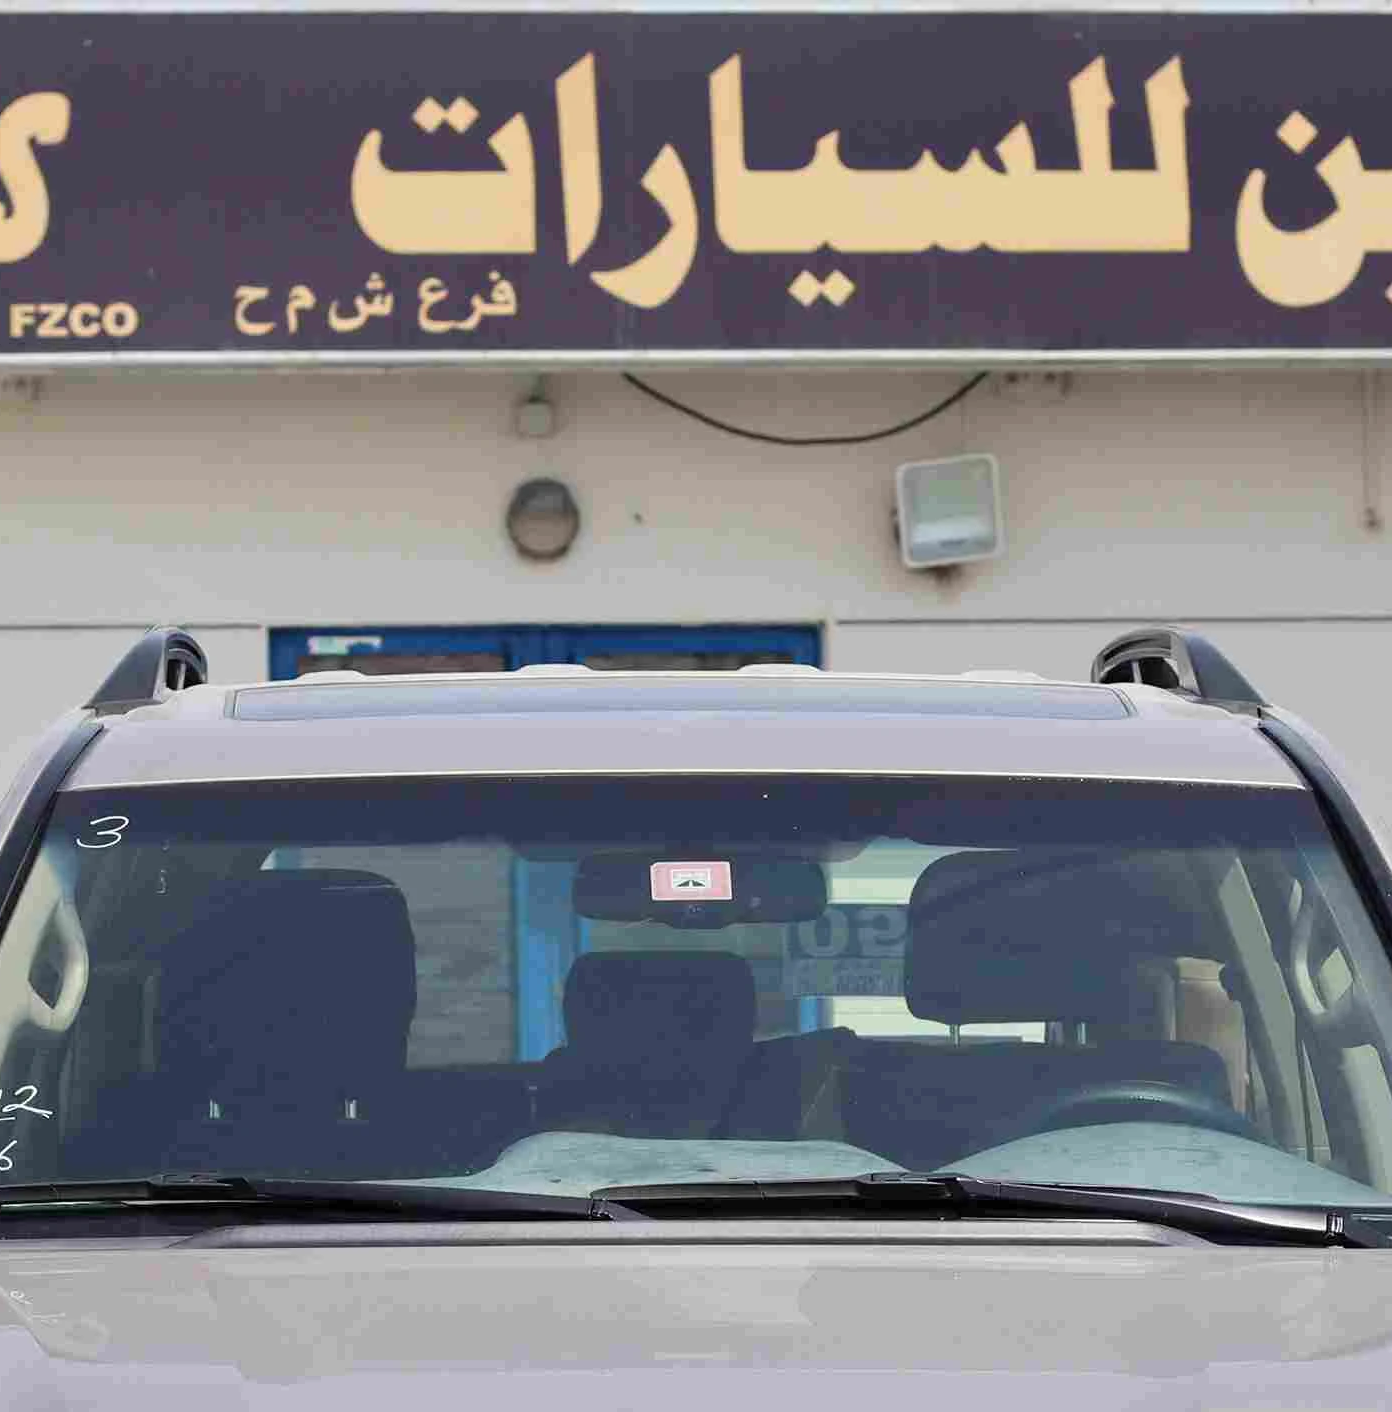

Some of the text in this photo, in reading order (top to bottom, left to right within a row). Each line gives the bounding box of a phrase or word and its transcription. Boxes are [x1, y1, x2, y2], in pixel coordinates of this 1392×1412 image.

[350, 52, 1191, 308] للسيارات
[9, 302, 139, 338] FZCO
[417, 269, 517, 333] فرع
[76, 815, 129, 848] 3
